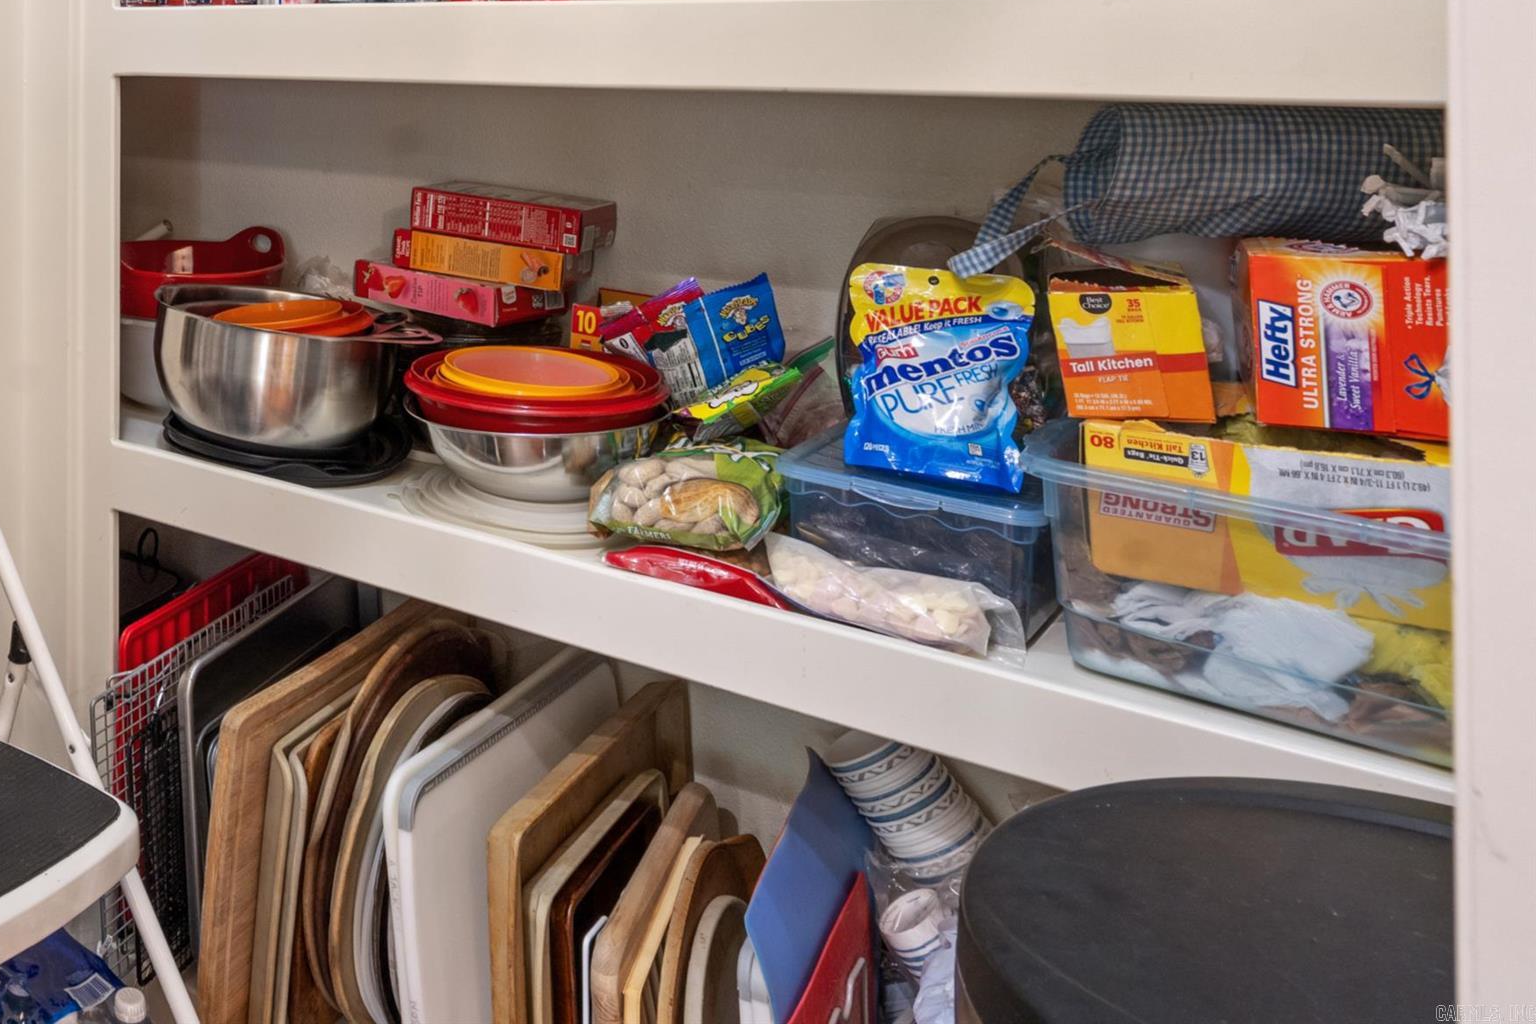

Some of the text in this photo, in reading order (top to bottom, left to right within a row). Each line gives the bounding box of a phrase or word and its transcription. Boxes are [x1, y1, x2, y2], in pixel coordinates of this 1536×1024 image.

[864, 295, 983, 332] VALUE PACK
[1085, 295, 1104, 306] Best
[1088, 301, 1111, 313] Choice
[1125, 298, 1142, 309] 35
[1414, 283, 1424, 325] Technology
[576, 309, 597, 335] 10
[722, 315, 771, 343] CUBES
[868, 316, 983, 345] RESEALABLE! Keep FRESH
[1263, 305, 1294, 382] Hefty
[1296, 278, 1319, 410] ULTRA STRONG
[865, 334, 1018, 396] mentos
[1070, 356, 1154, 374] Tall Kitchen
[880, 363, 999, 421] PURE FRESH
[1335, 361, 1348, 402] Lavender
[1347, 351, 1362, 410] Sweet Vanilla
[1089, 432, 1115, 450] 80
[1125, 439, 1164, 451] Kitchen
[1190, 449, 1206, 463] 13
[1101, 506, 1192, 527] GUARANTEED
[1103, 492, 1213, 528] STRONG
